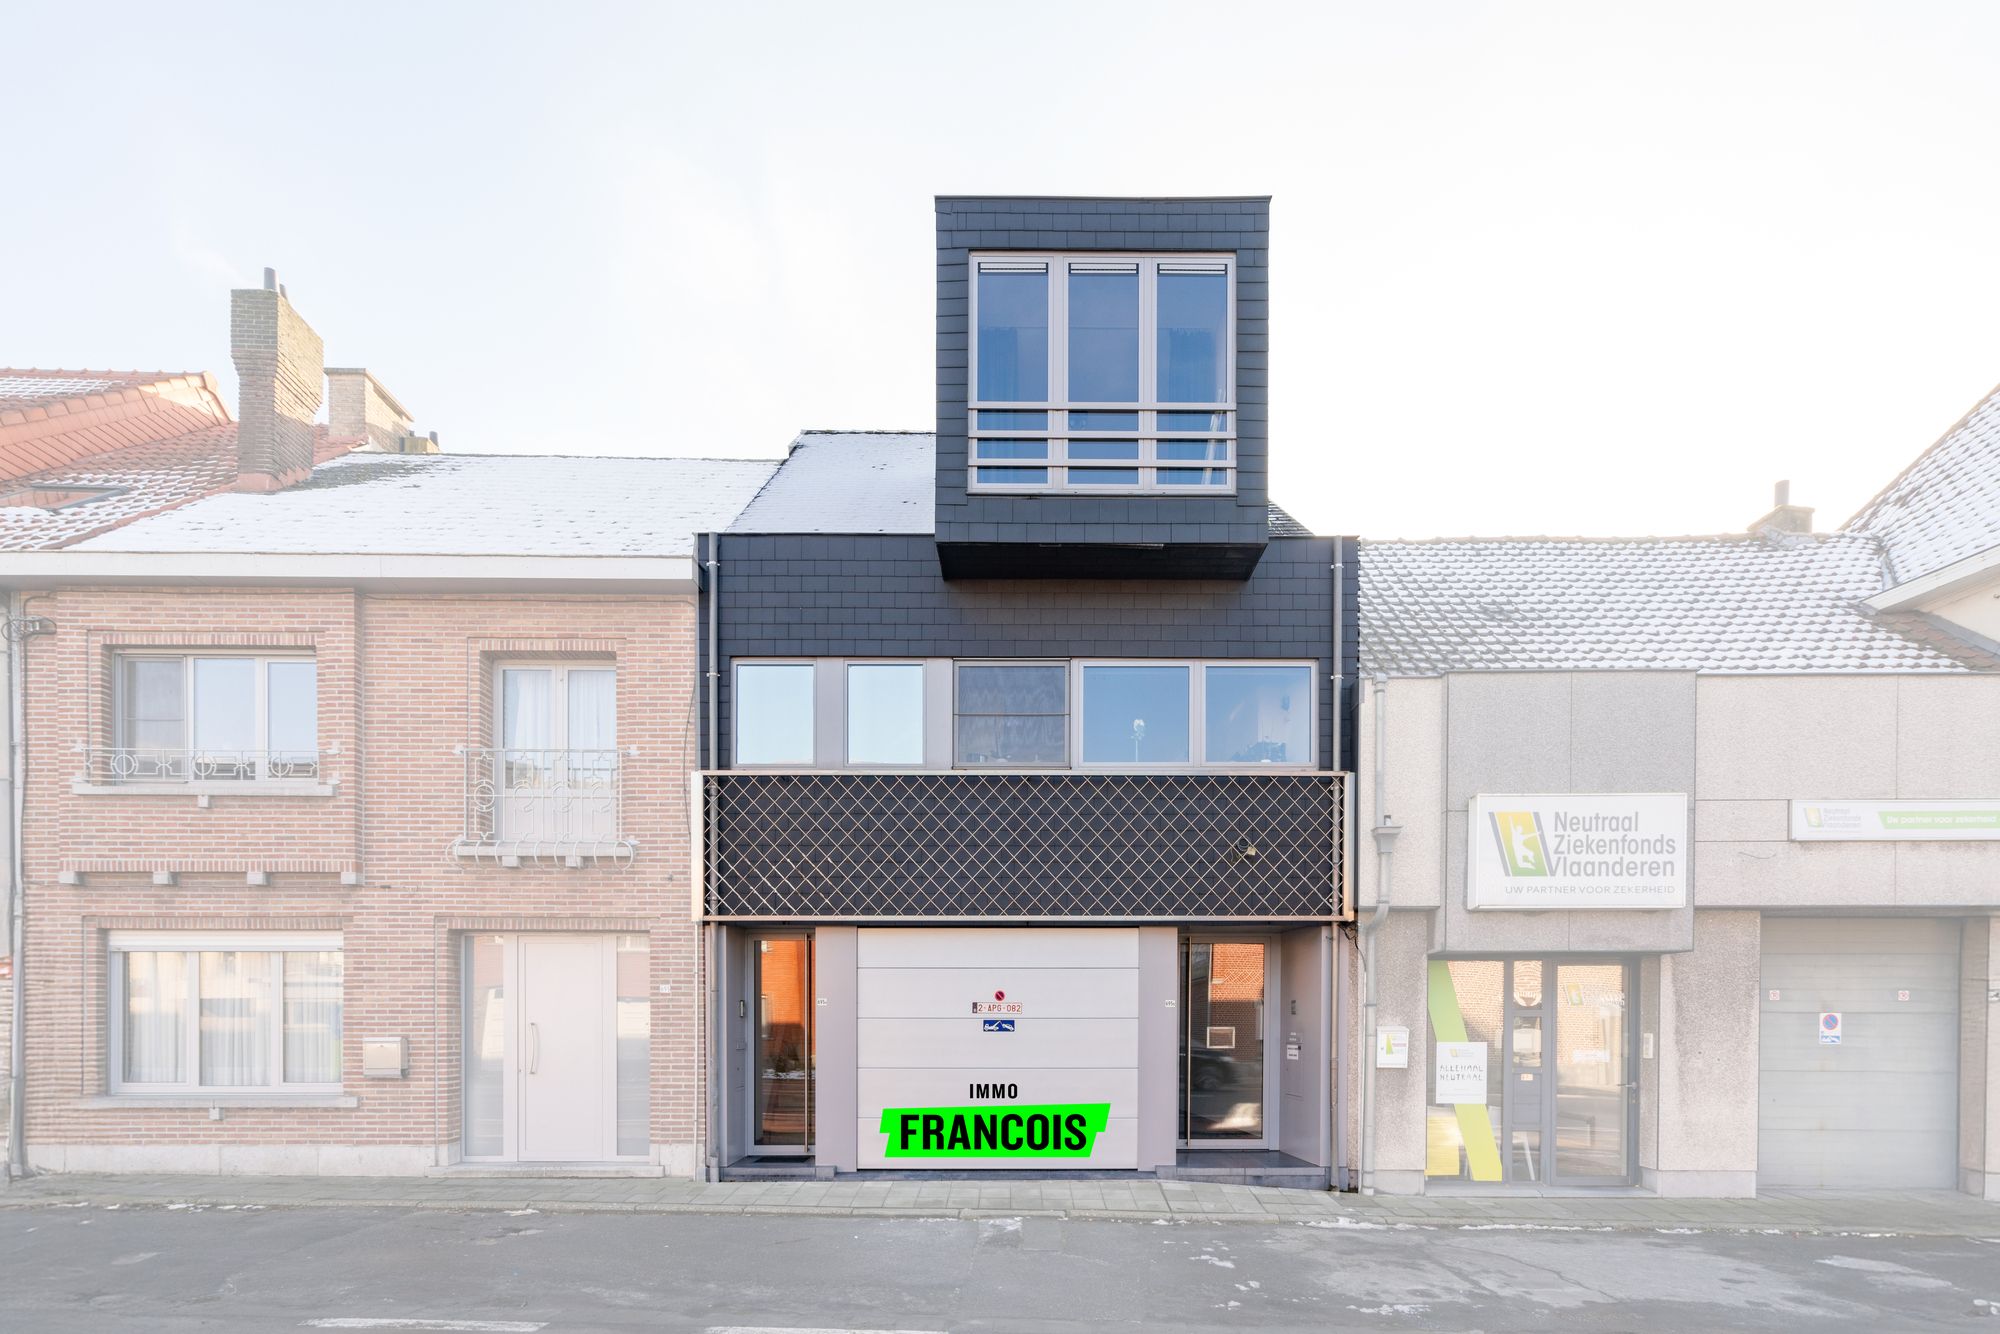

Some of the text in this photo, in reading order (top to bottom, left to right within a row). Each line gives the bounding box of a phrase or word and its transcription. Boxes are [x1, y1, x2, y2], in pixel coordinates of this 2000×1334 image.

[1554, 811, 1639, 832] Neutraal
[1553, 833, 1676, 855] Ziekenfonds
[1550, 856, 1675, 877] Vlaanderen
[1505, 886, 1676, 894] UW PARTNER VOOR ZEKERHEID
[978, 1003, 1021, 1013] 2-APG-082
[1440, 1064, 1484, 1072] ALLEMAAL
